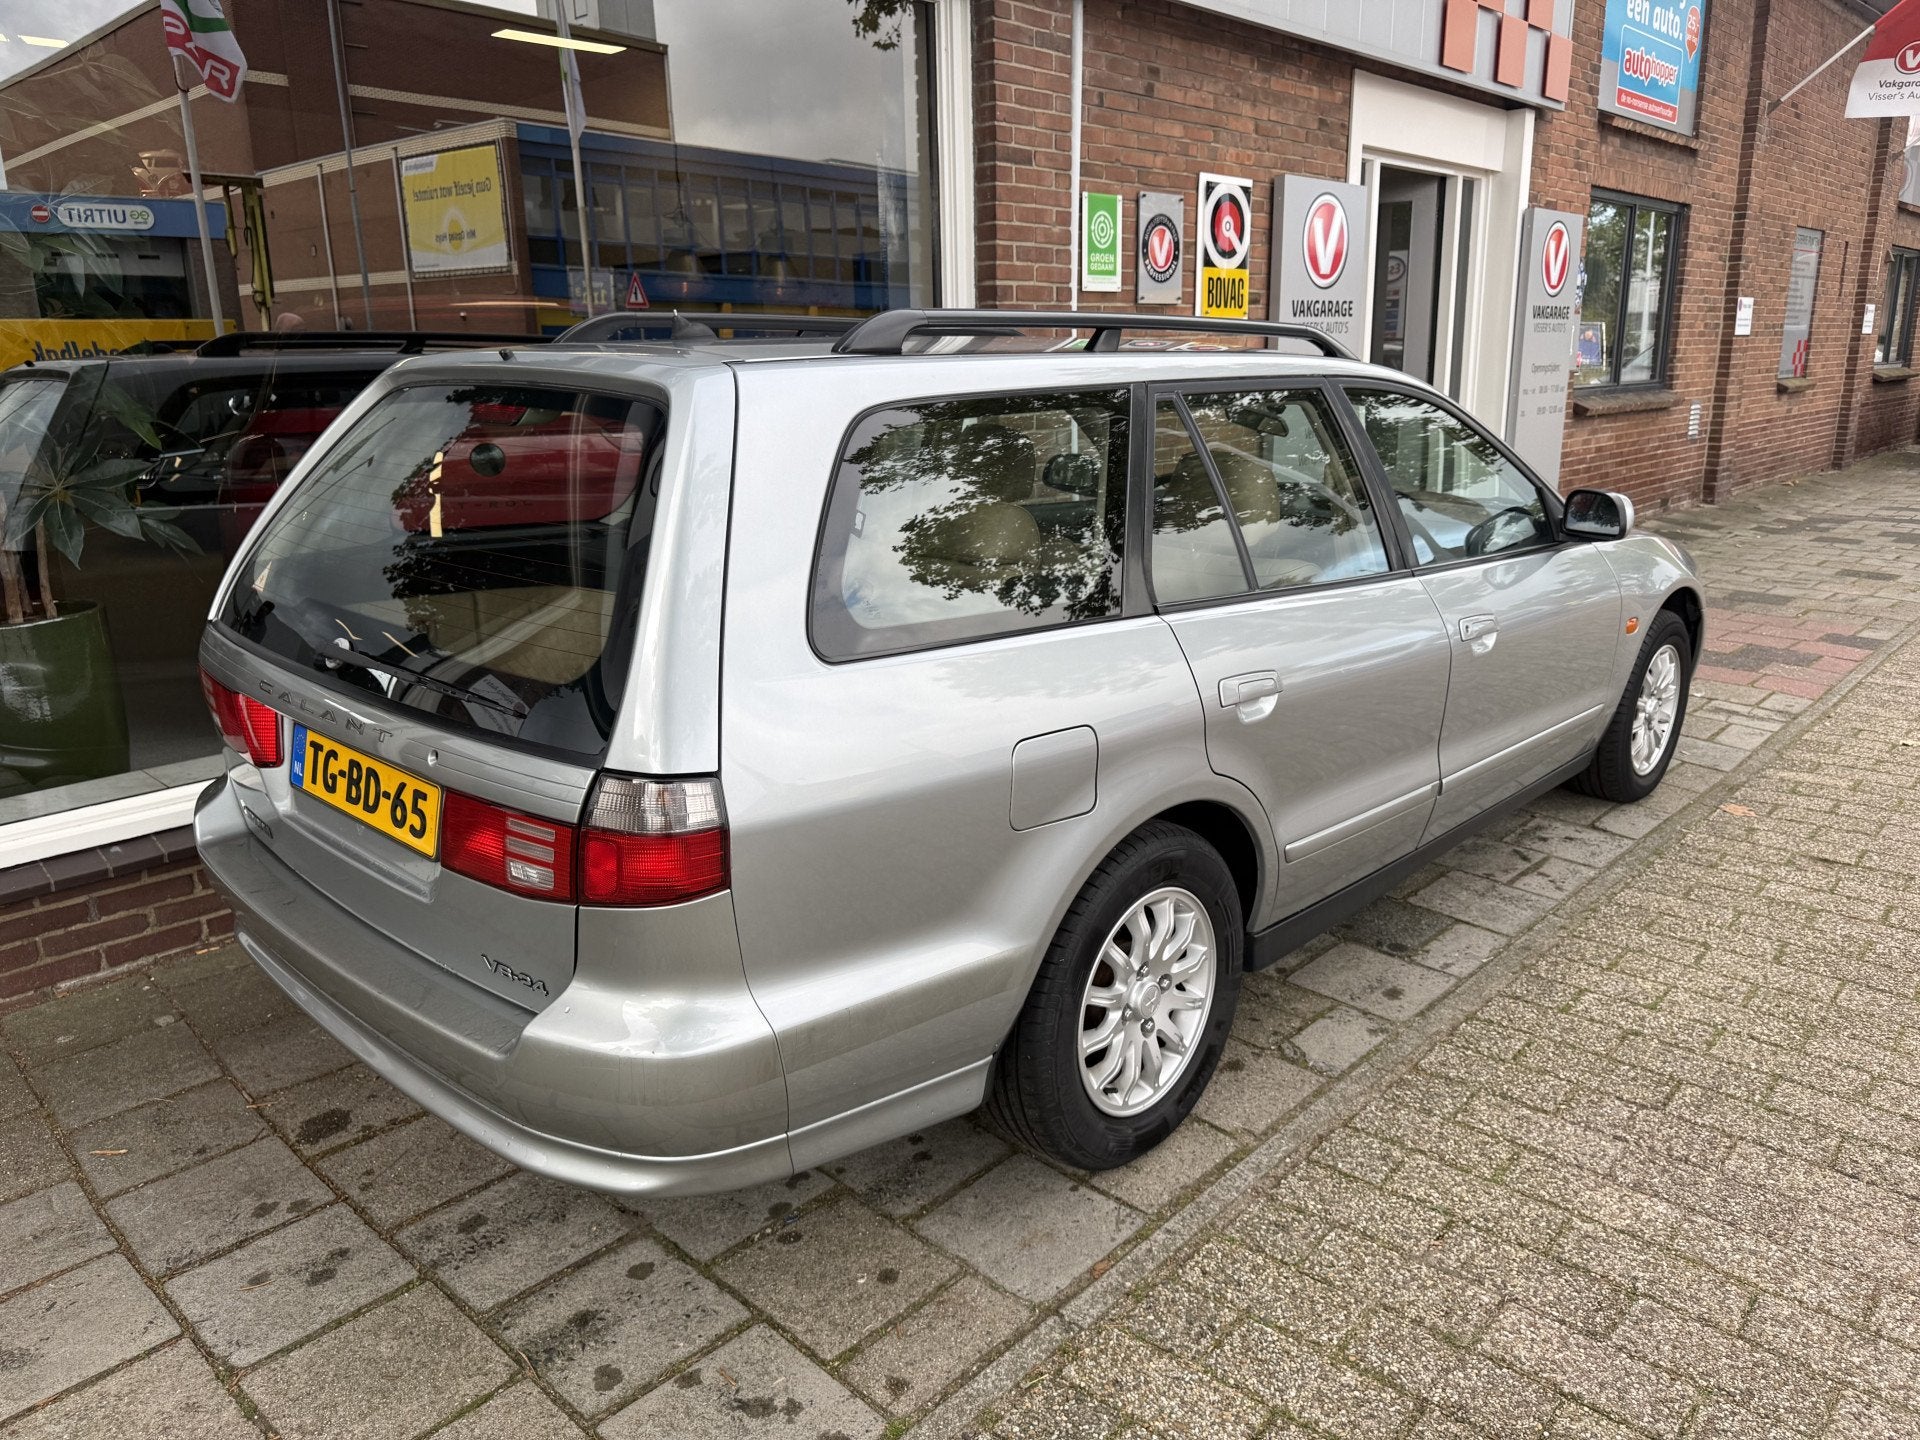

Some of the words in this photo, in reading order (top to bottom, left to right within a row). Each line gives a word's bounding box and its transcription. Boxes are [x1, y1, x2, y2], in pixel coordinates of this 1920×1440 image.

[1653, 6, 1683, 41] auto.
[1624, 48, 1678, 85] autohopper
[1868, 92, 1905, 101] Visser's
[1090, 253, 1115, 263] GROEN
[1144, 258, 1178, 282] PROFESSIONAL
[1207, 276, 1245, 310] BOVAG
[1291, 299, 1354, 318] VAKGARAGE
[1532, 305, 1570, 320] VAKGARAGE
[259, 679, 394, 744] GALANT
[293, 761, 303, 777] NL
[308, 739, 428, 840] TG-BD-65
